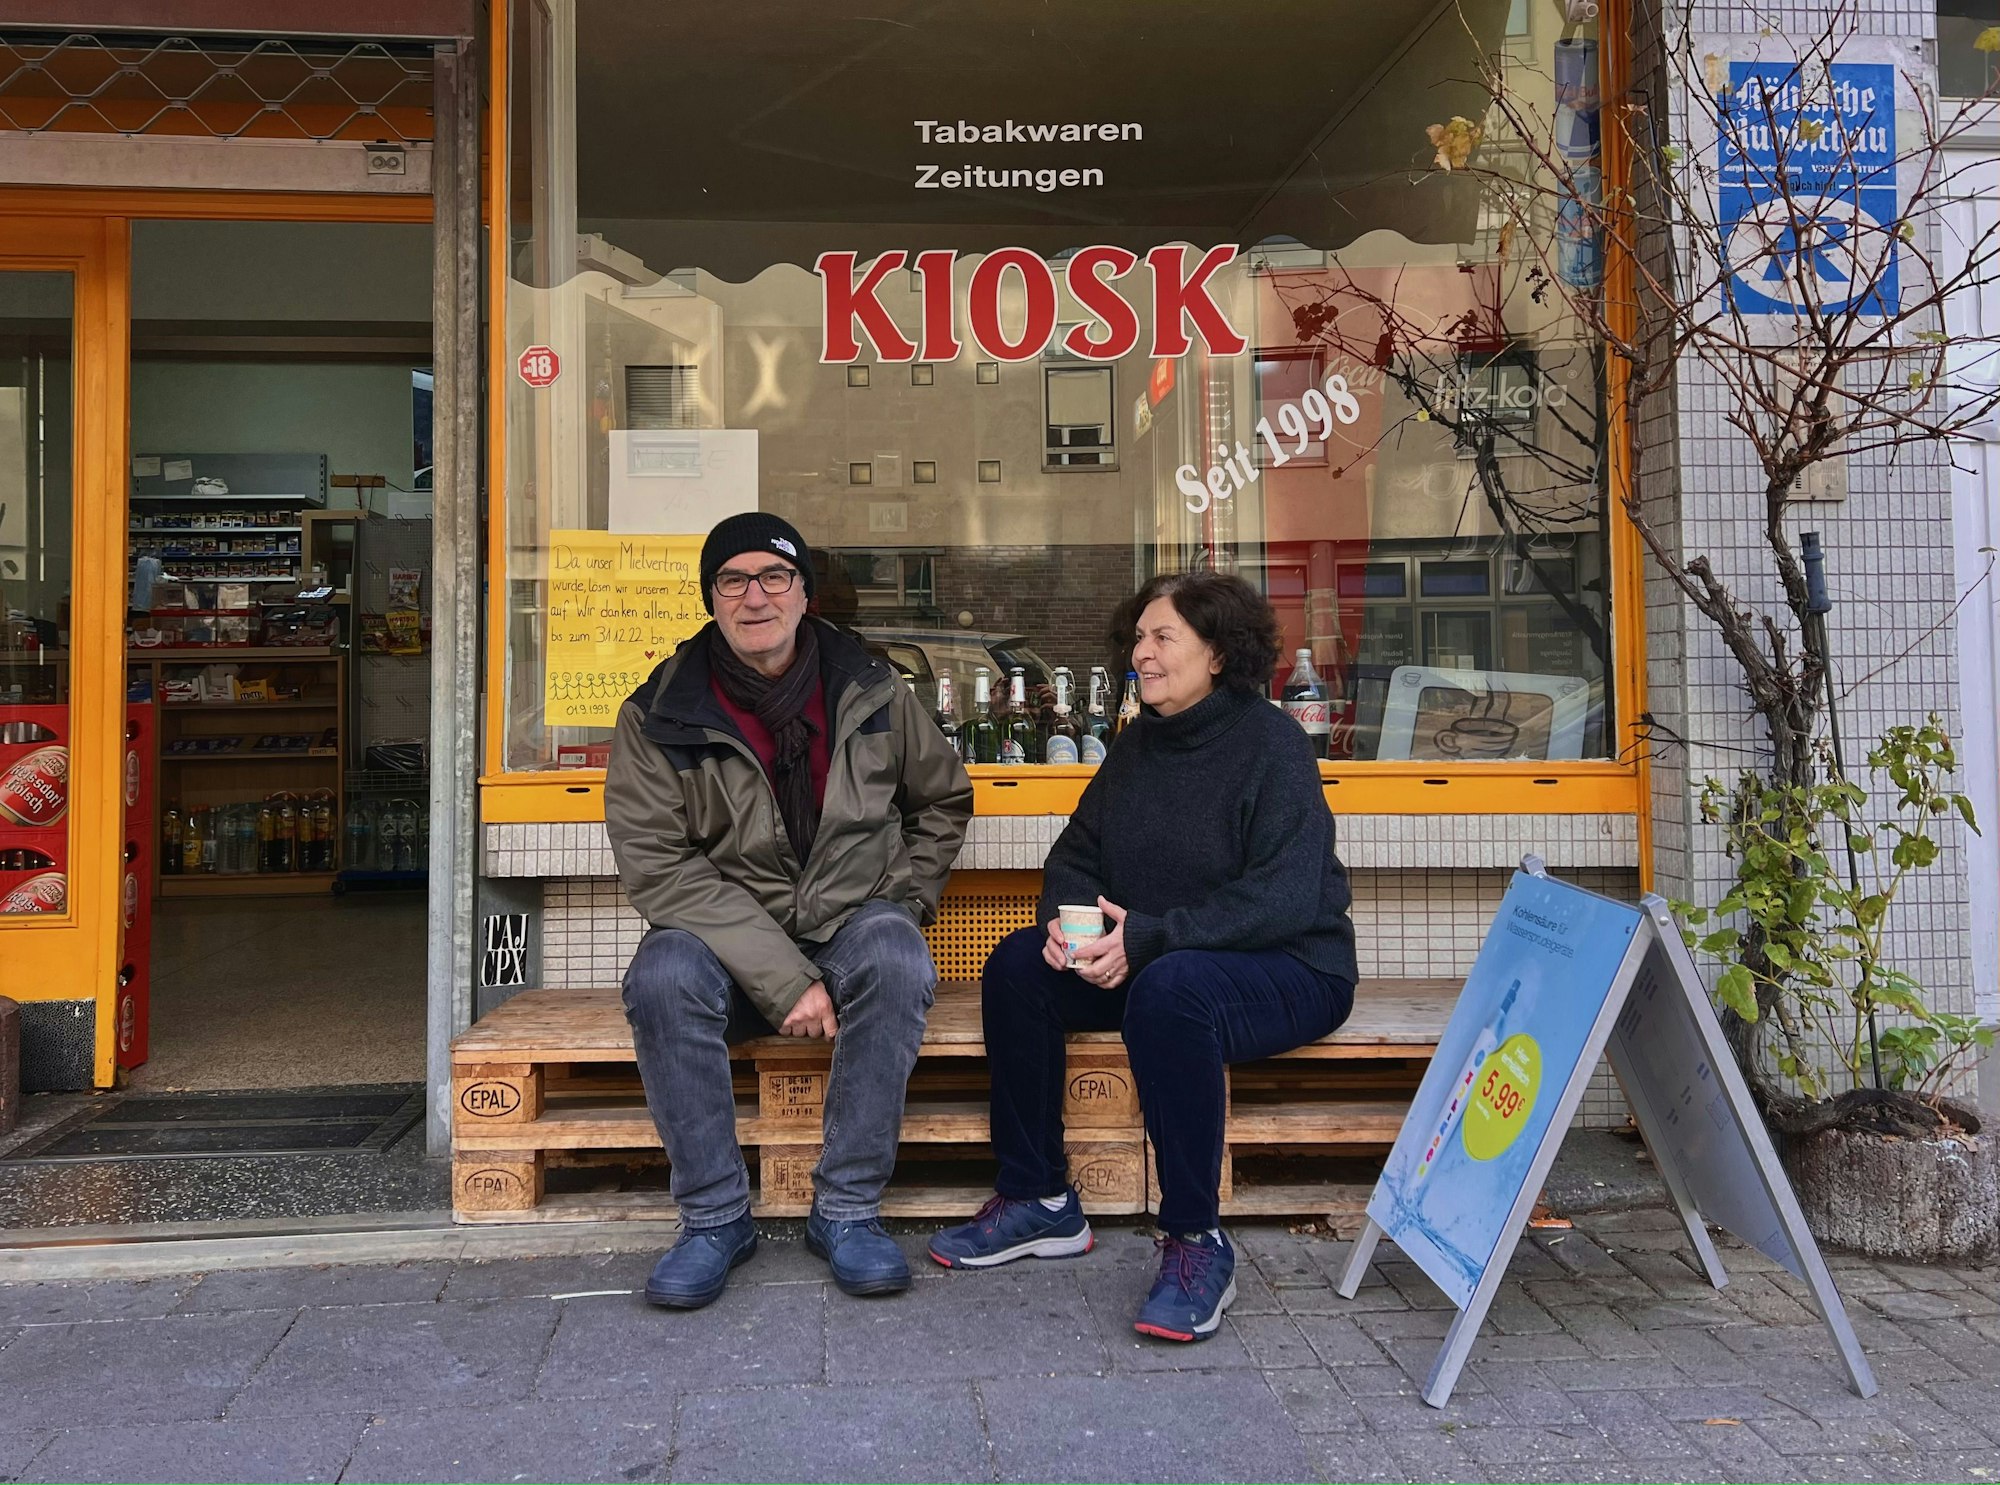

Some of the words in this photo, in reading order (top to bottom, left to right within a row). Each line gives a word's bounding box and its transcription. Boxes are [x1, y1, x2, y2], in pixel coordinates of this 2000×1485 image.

[914, 119, 1143, 144] Tabakwaren
[914, 164, 1104, 192] Zeitungen
[813, 243, 1250, 364] KIOSK
[527, 355, 552, 378] 18
[1175, 441, 1260, 514] Seit
[1256, 374, 1361, 468] 1998
[553, 545, 580, 570] Da
[586, 558, 613, 570] unser
[619, 542, 689, 582] Mietvertrag
[615, 585, 628, 594] wir
[636, 584, 669, 595] unseren
[600, 599, 638, 618] danken
[643, 601, 673, 622] allen,
[676, 603, 690, 620] die
[569, 633, 590, 642] zum
[470, 1088, 511, 1110] EPAL
